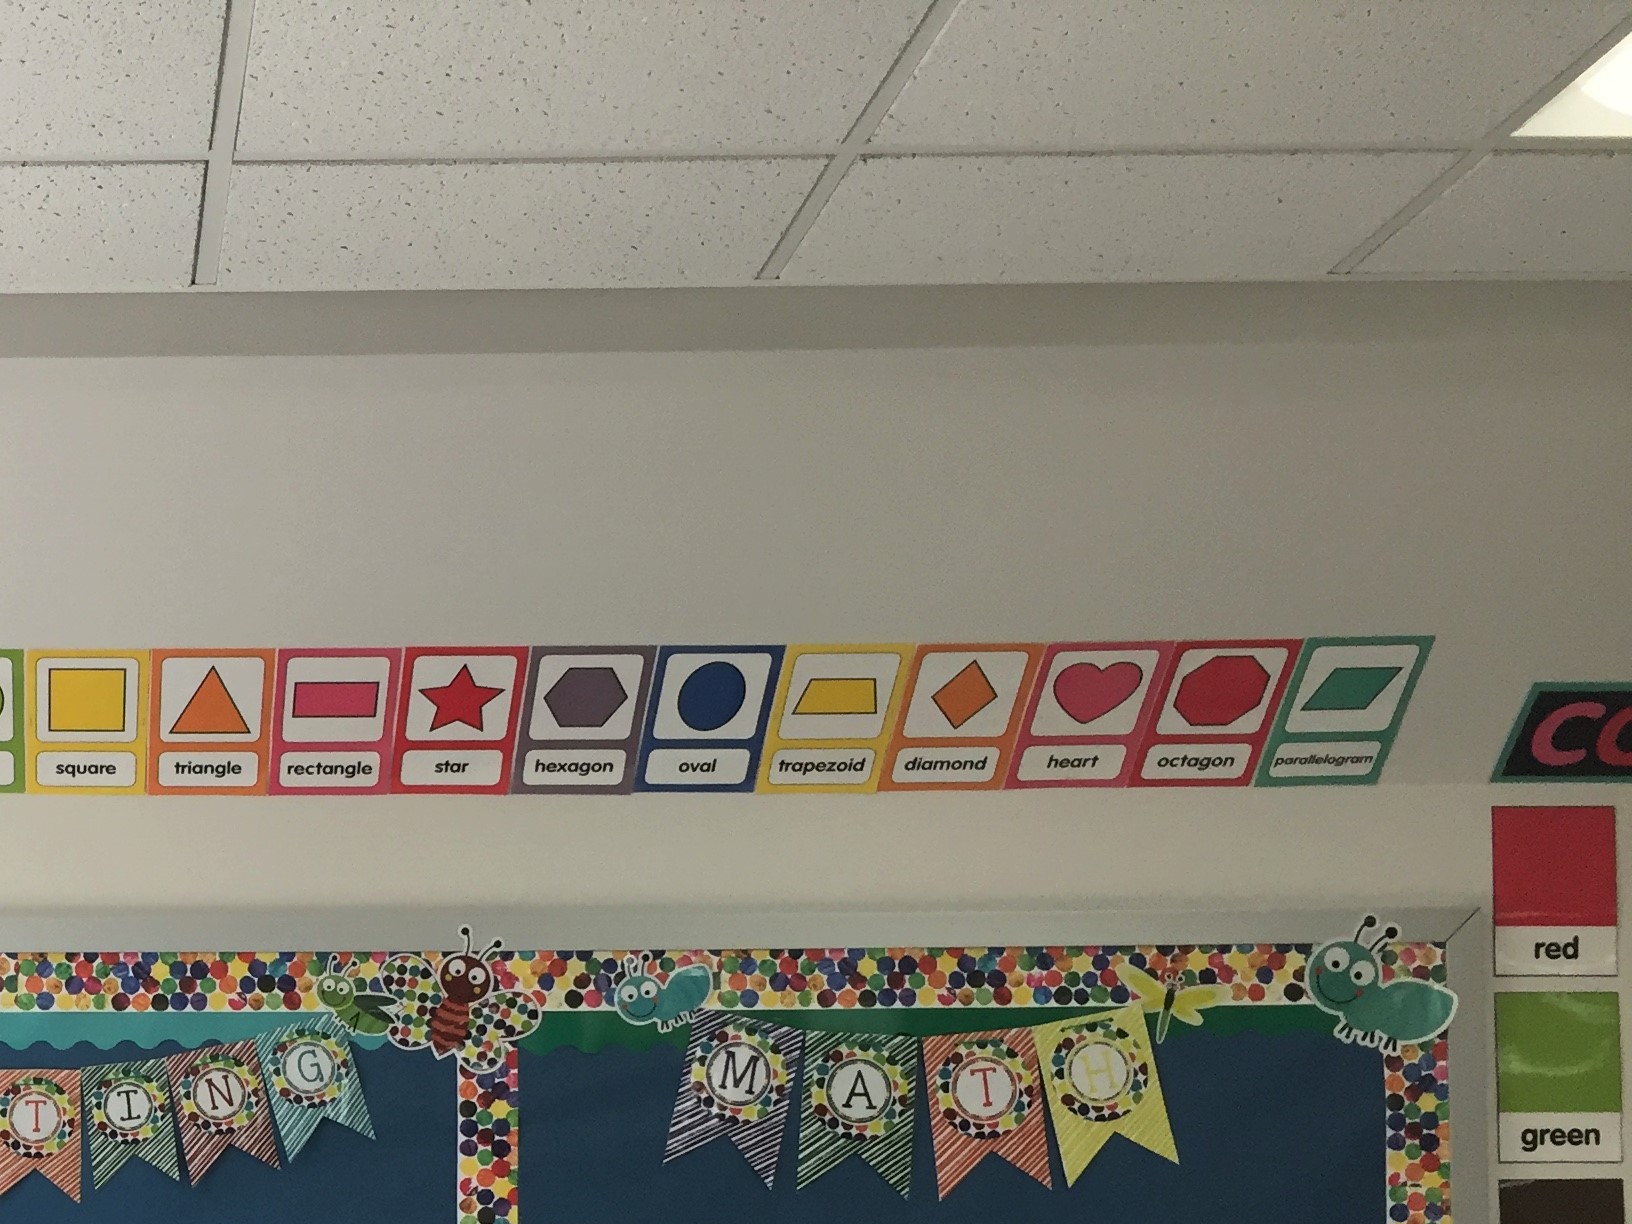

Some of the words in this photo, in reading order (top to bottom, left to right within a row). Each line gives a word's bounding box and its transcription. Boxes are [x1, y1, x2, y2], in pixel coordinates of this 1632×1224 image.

[55, 759, 117, 779] square
[173, 759, 243, 779] triangle
[287, 759, 372, 779] rectangle
[433, 759, 470, 774] star
[533, 759, 614, 778] hexagon
[678, 758, 717, 774] oval
[778, 756, 866, 776] trapezoid
[903, 755, 988, 772] diamond
[1046, 753, 1100, 770] heart
[1156, 754, 1235, 771] octagon
[1273, 751, 1374, 770] parallelogram
[1533, 935, 1580, 960] red
[723, 1048, 1115, 1110] MATH
[1520, 1126, 1601, 1153] green
